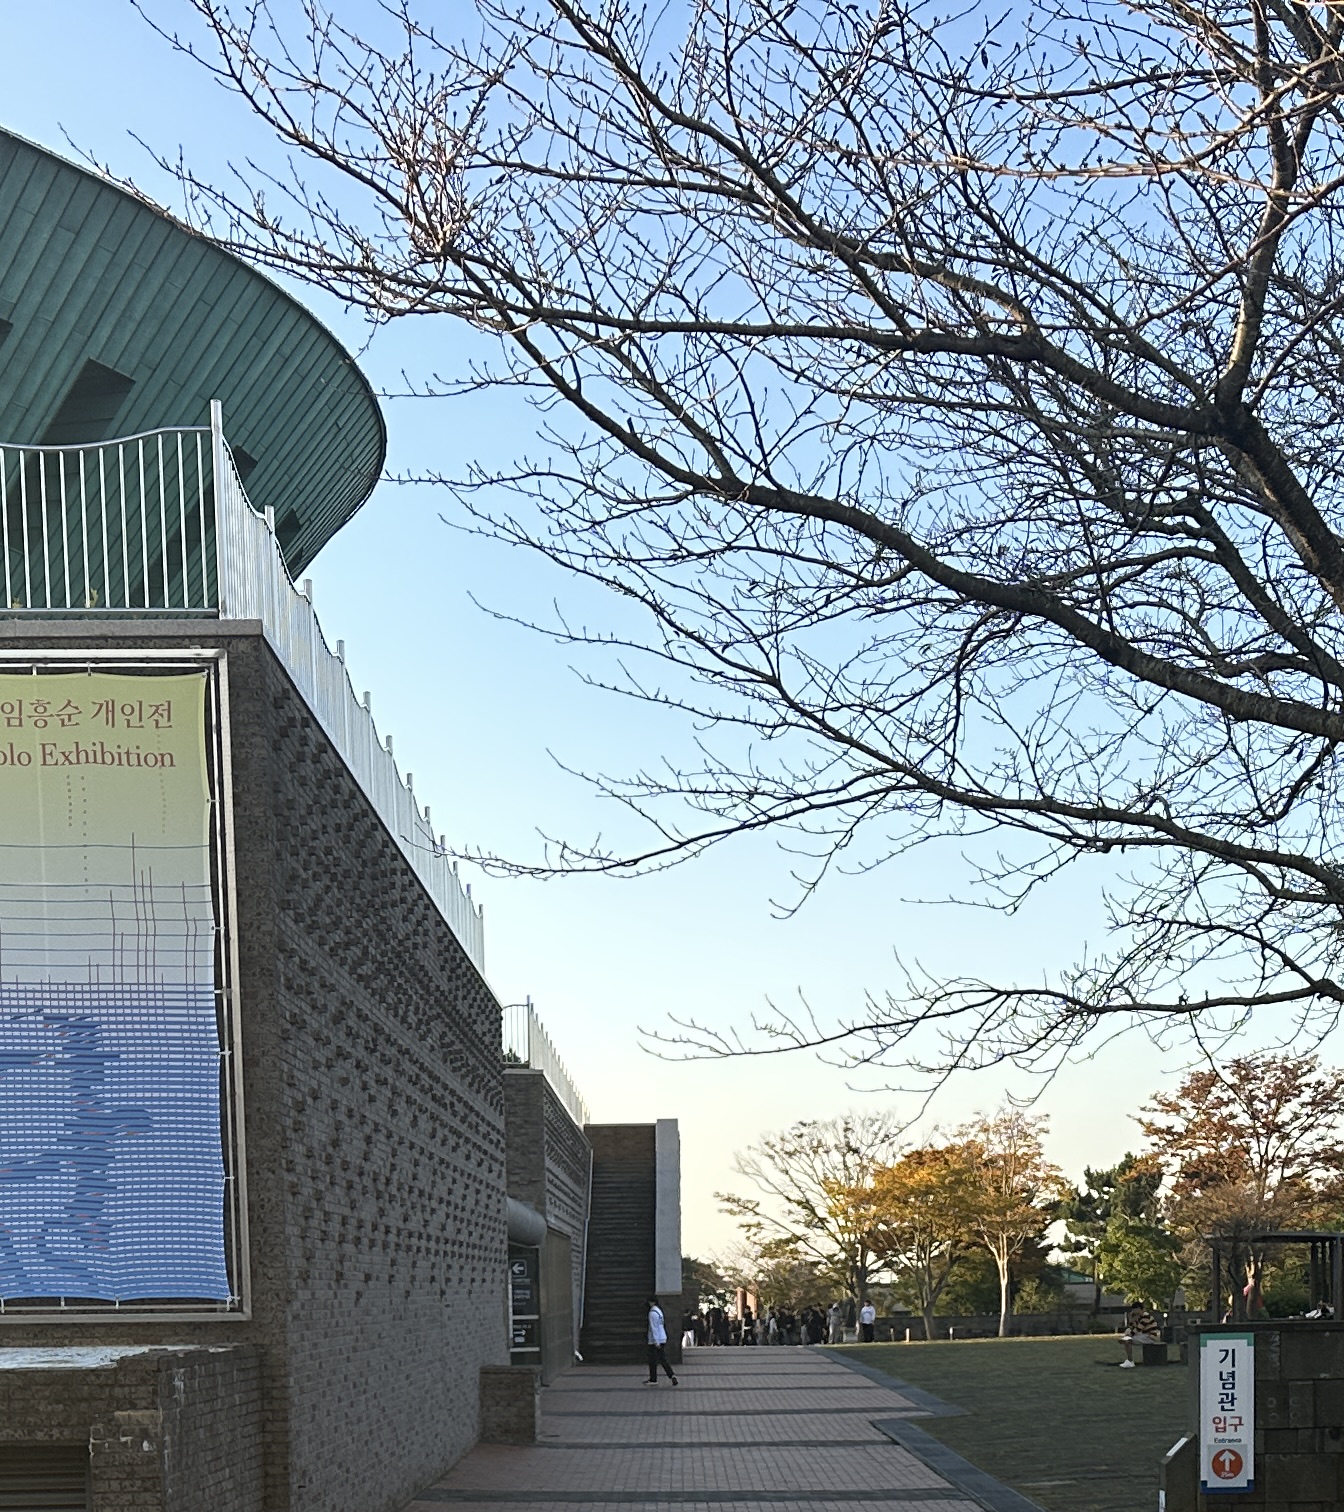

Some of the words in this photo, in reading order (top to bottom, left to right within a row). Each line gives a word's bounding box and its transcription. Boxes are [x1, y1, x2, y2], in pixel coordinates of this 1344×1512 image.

[0, 698, 82, 729] 임흥순
[90, 698, 174, 729] 개인전
[40, 741, 176, 768] Exhibition
[1217, 1348, 1238, 1413] 기념관
[1212, 1415, 1245, 1434] 입구
[1213, 1437, 1243, 1445] Entrance
